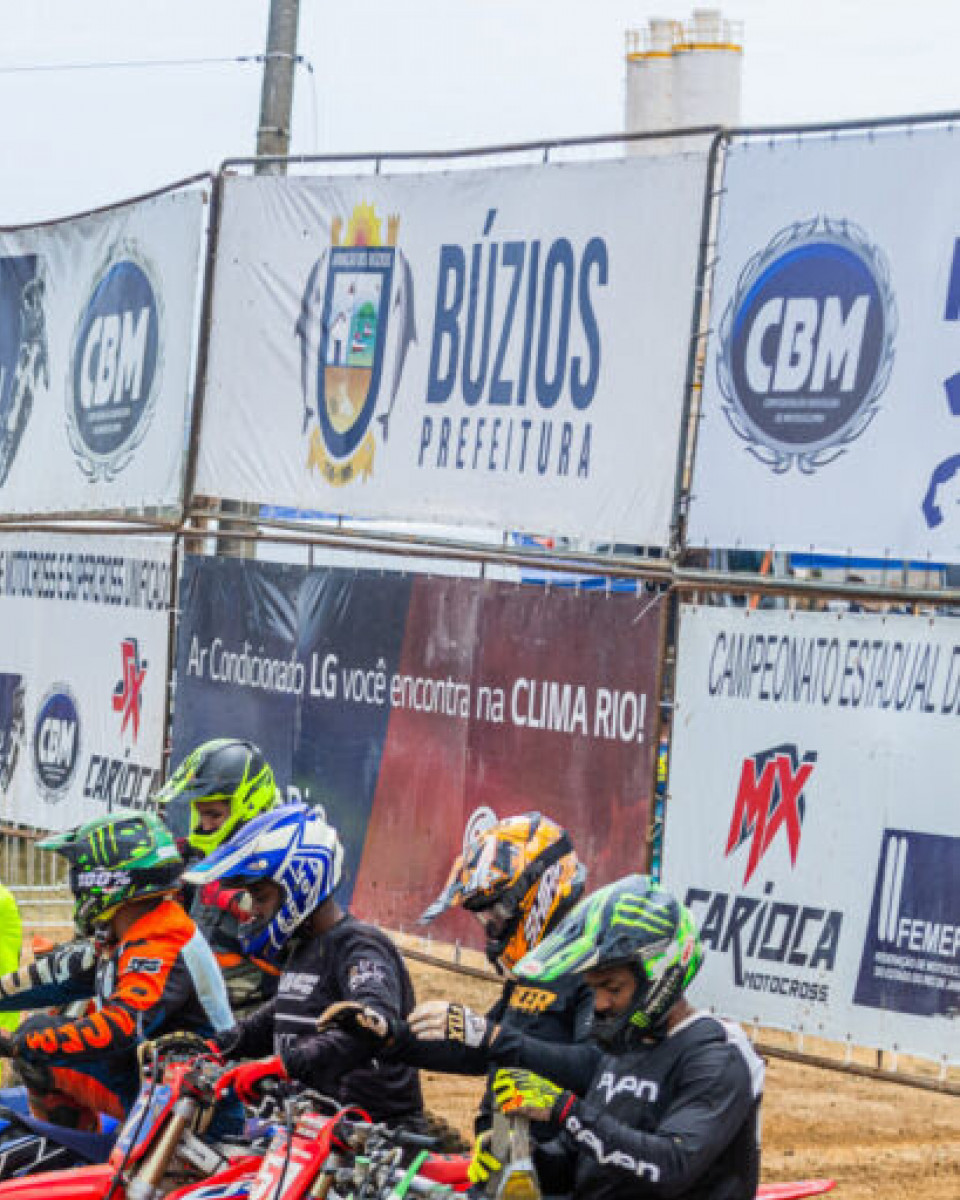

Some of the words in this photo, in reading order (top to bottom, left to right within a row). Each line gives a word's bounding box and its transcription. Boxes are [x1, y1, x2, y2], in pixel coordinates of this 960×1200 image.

[80, 307, 150, 408] CBM
[426, 208, 608, 410] BÚZIOS
[745, 295, 870, 393] CBM
[418, 415, 592, 478] PREFEITURA
[187, 635, 208, 676] Ar
[309, 652, 338, 698] LG
[343, 658, 387, 705] você
[390, 672, 471, 719] encontra
[476, 685, 504, 723] na
[510, 677, 588, 735] CLIMA
[593, 687, 648, 744] RIO!
[708, 631, 838, 704] CAMPEONATO
[838, 639, 936, 713] ESTADUAL
[725, 748, 816, 887] MX
[742, 972, 829, 1002] MOTOCROSS
